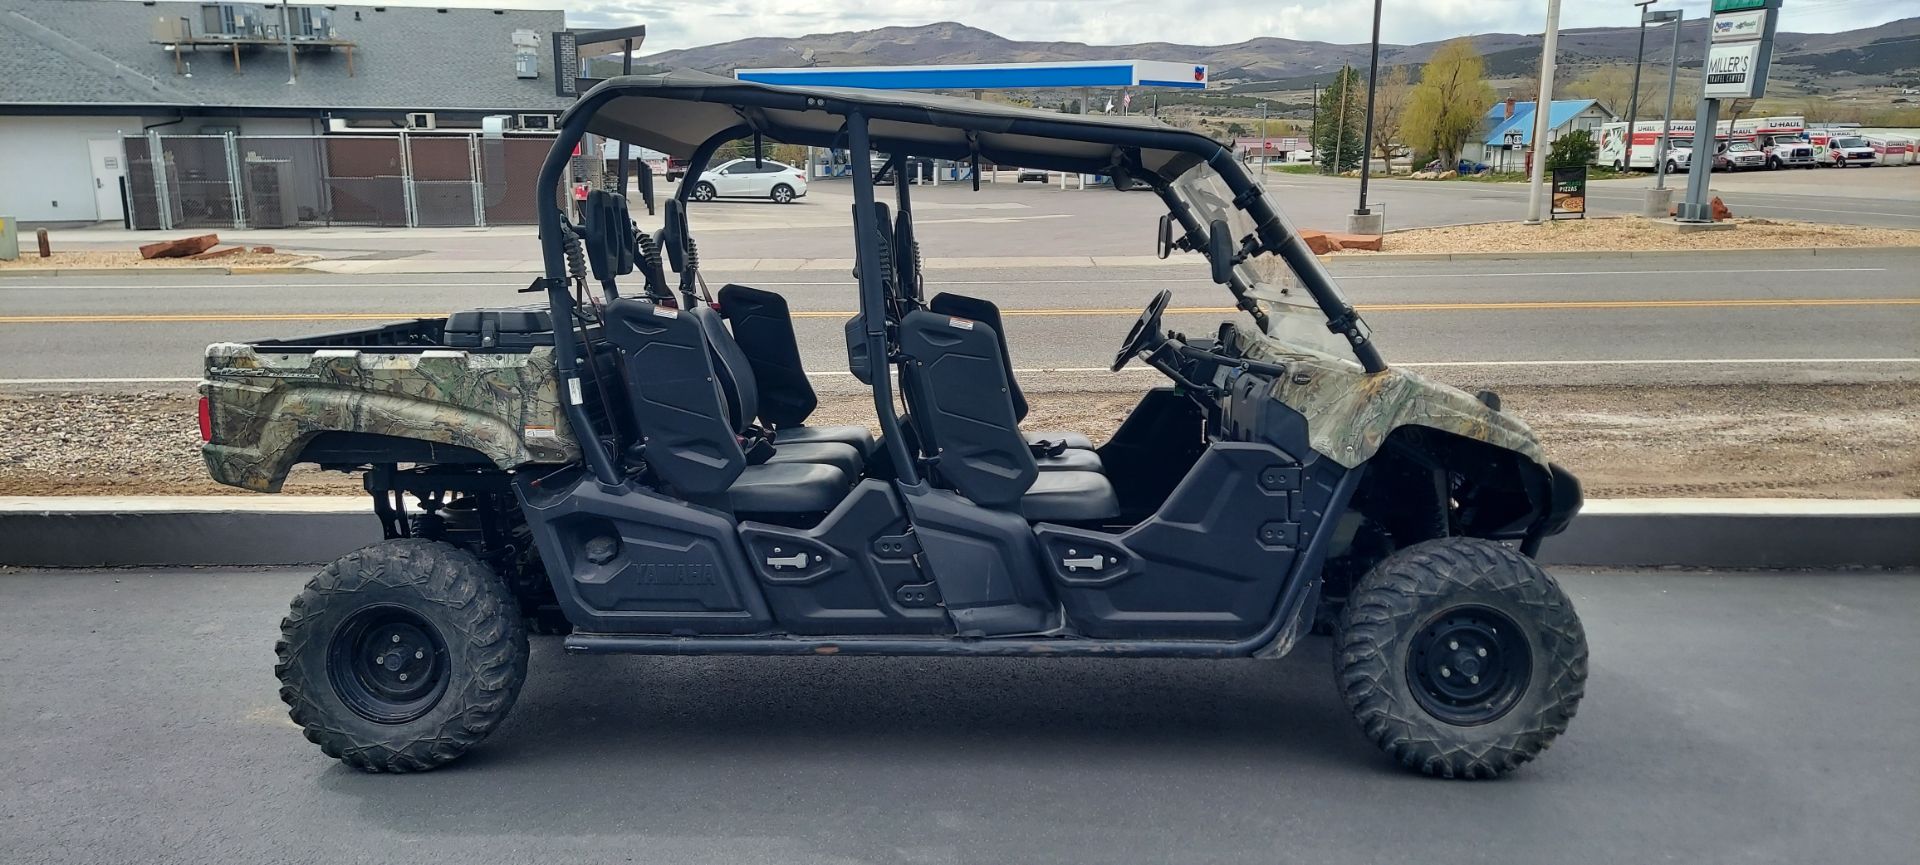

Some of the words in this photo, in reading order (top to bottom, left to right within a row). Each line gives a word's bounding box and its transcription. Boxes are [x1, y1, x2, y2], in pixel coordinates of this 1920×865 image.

[1709, 55, 1749, 73] MILLER'S
[1709, 74, 1725, 84] TRAVEL
[1726, 73, 1745, 83] CENTER
[631, 562, 716, 586] YAMAHA
